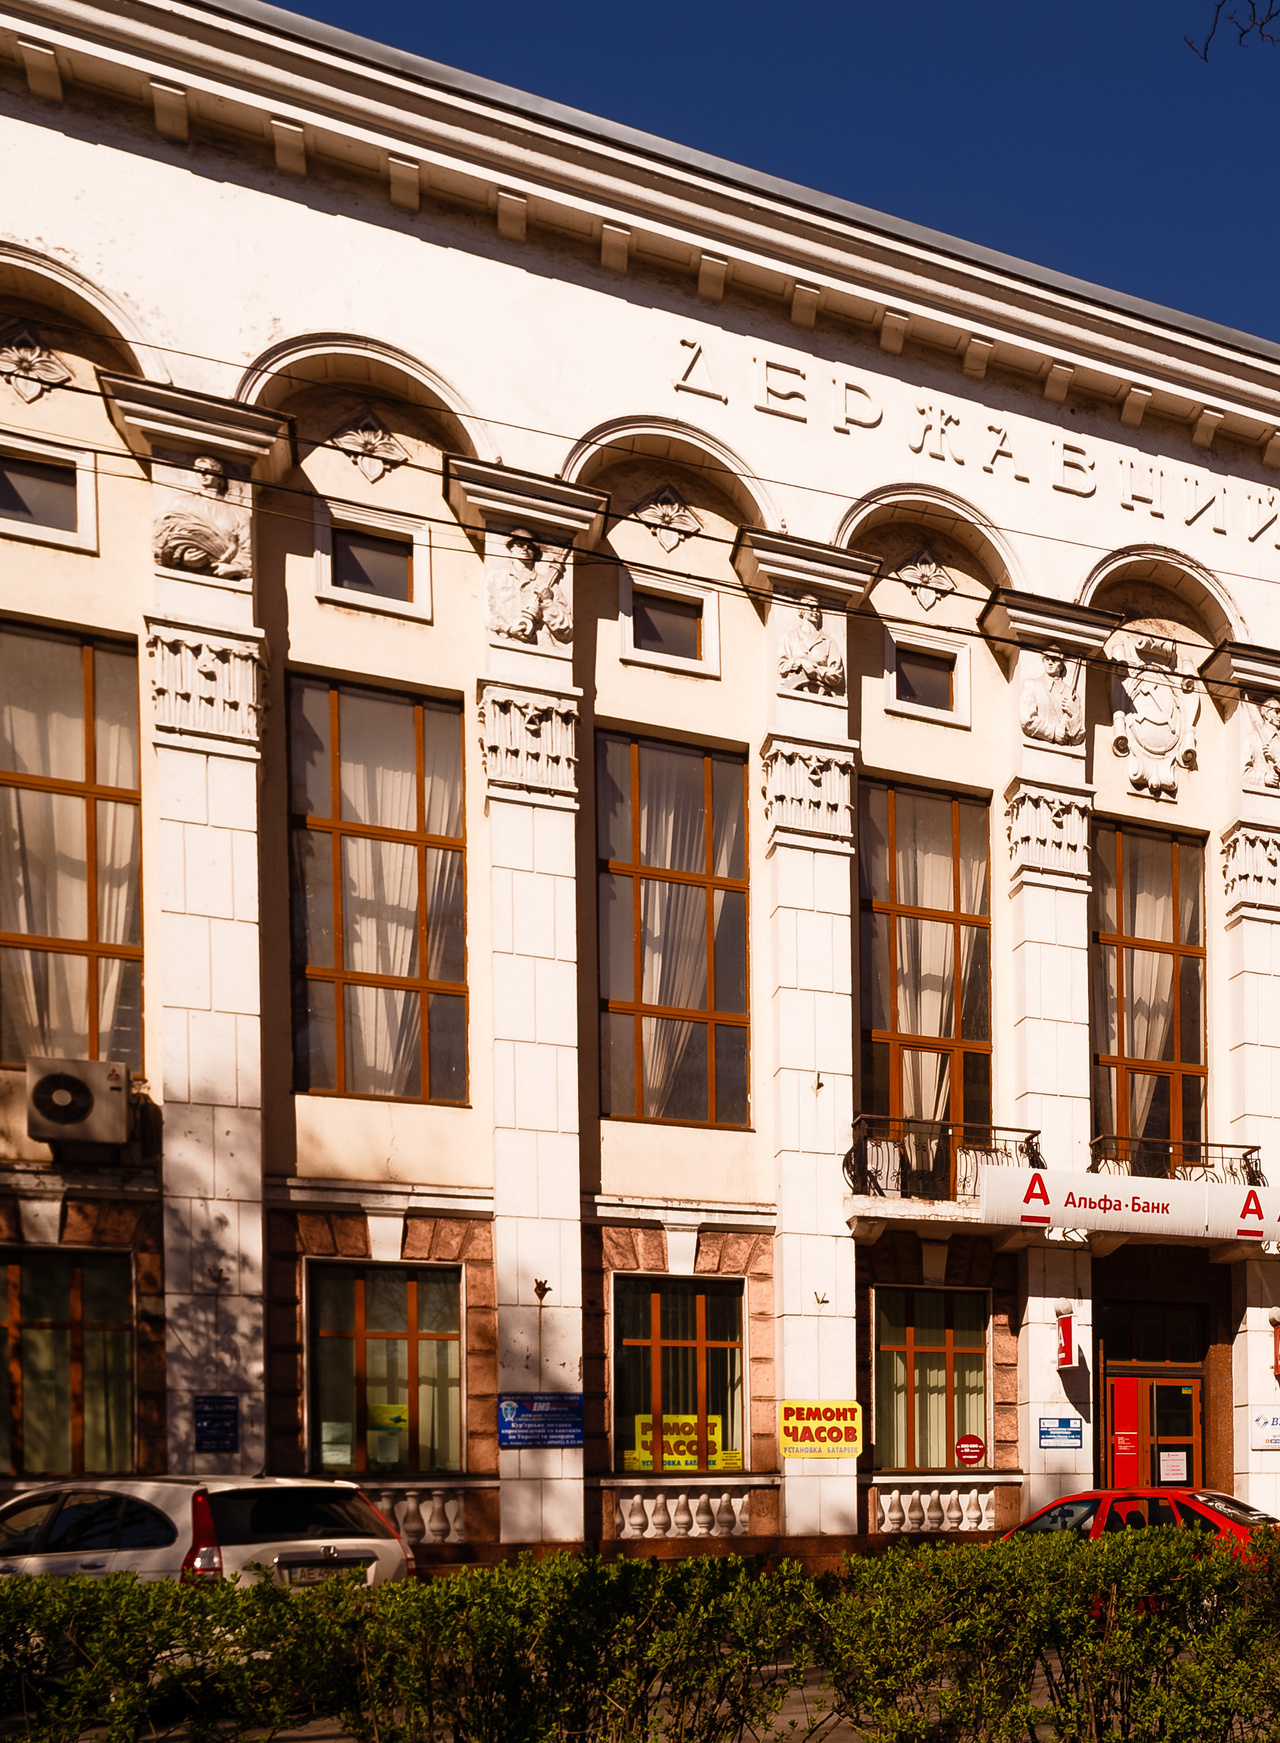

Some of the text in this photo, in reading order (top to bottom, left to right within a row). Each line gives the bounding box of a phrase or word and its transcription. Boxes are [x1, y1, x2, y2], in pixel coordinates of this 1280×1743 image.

[532, 1402, 551, 1411] EMS
[783, 1406, 857, 1421] РЕМОНТ
[641, 1422, 717, 1435] РМОТ
[783, 1426, 857, 1442] ЧАСОВ
[300, 1568, 315, 1580] AE
